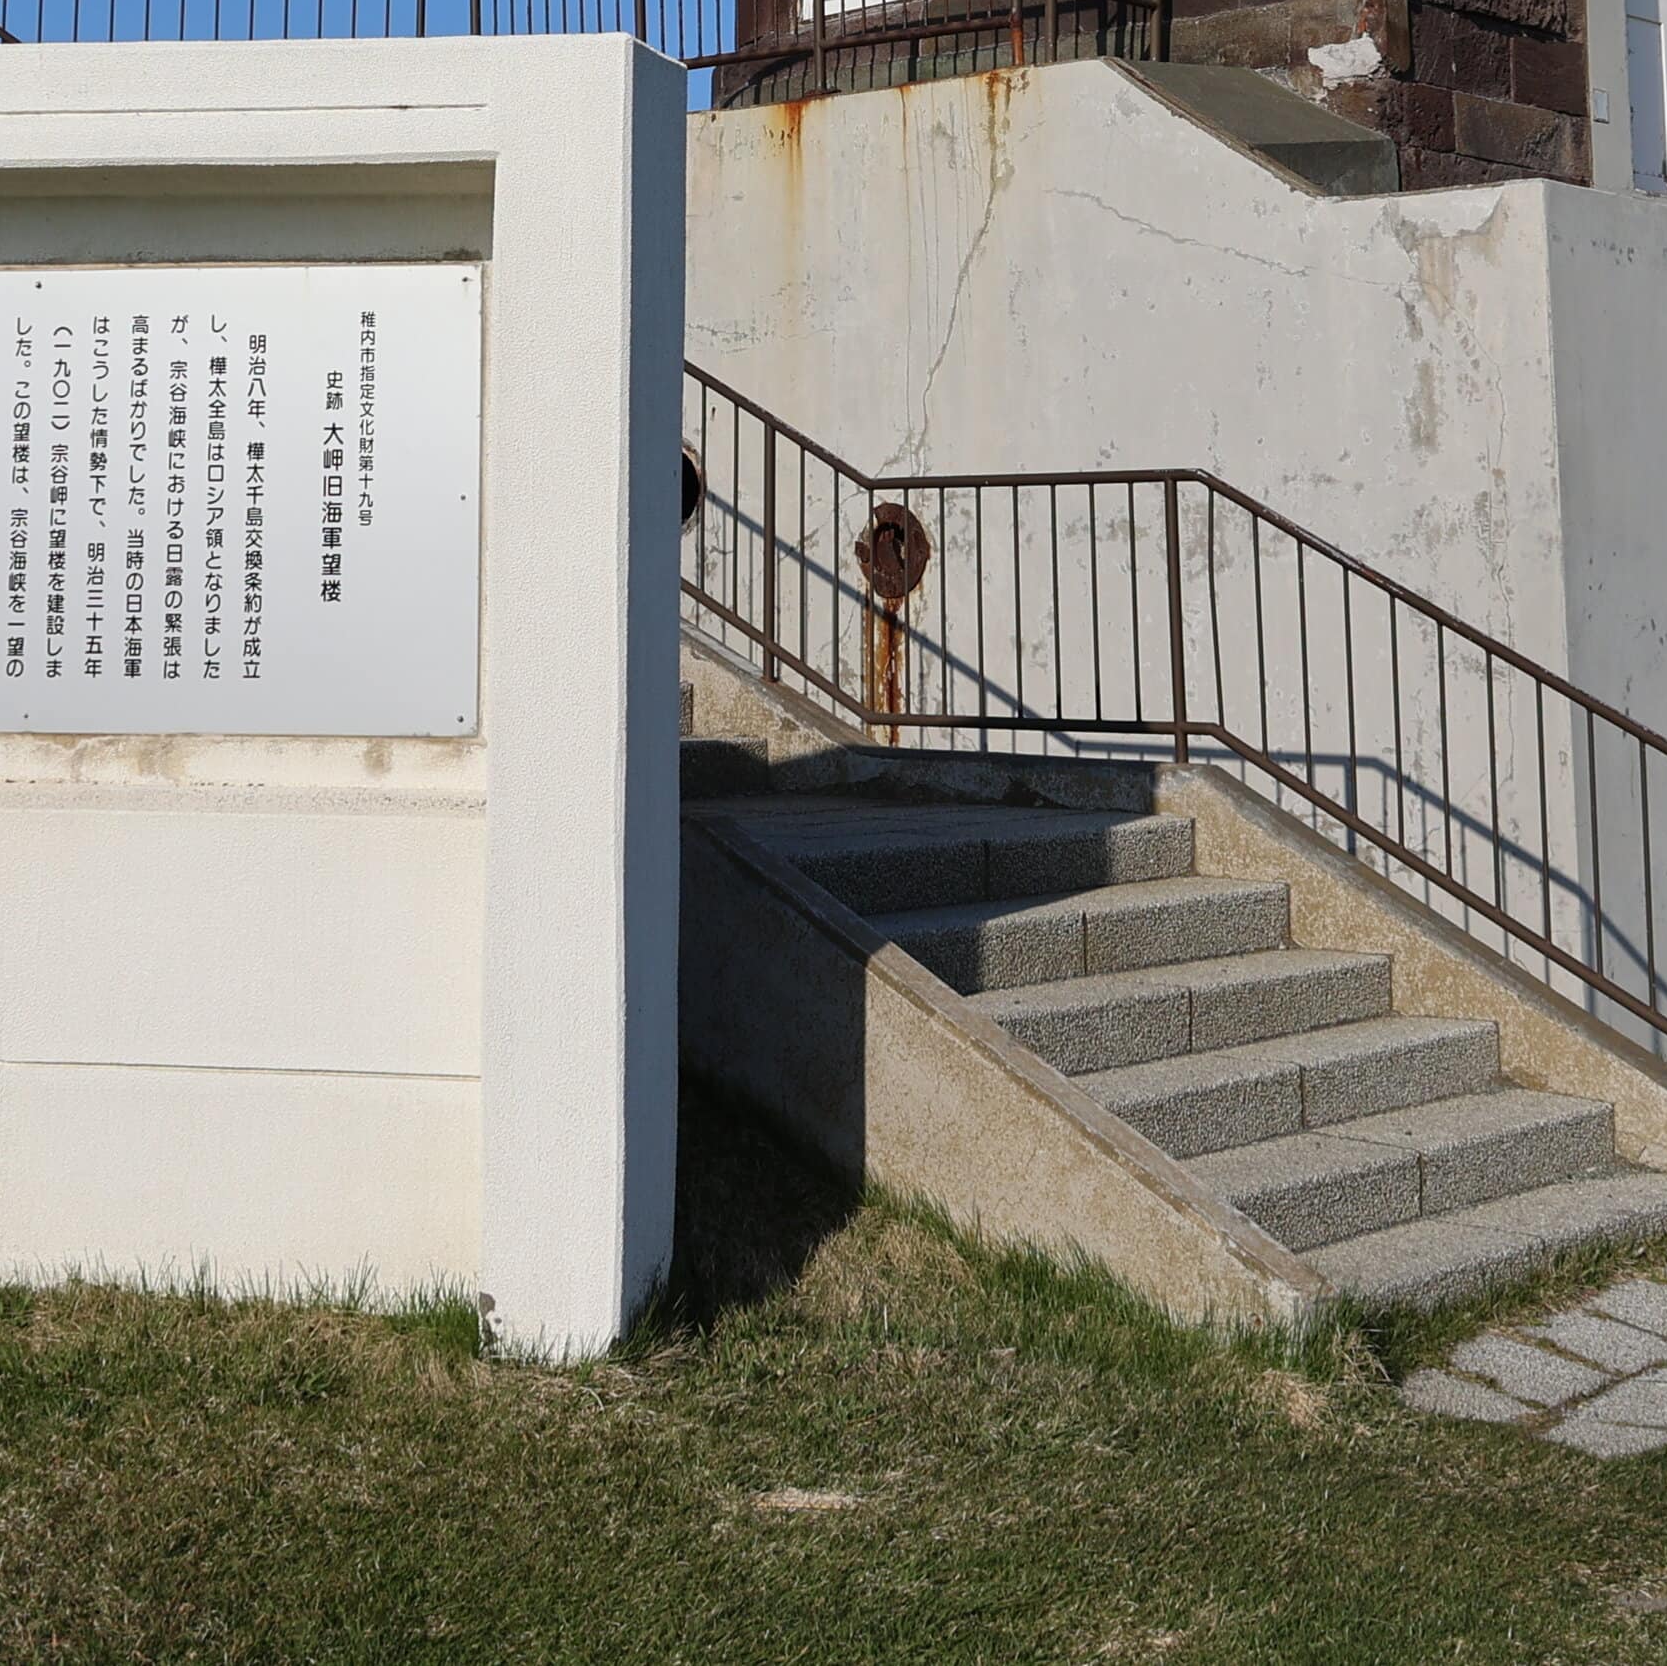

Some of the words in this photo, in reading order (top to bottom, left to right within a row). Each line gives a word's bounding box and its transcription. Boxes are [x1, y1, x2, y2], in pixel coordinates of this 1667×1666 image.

[5, 317, 33, 678] した。この望楼は、宗谷海峡を一望の
[83, 315, 111, 679] はこうした情勢下で、明治三十五年
[123, 314, 150, 679] 高まるばかりでした。当時の日本海軍
[163, 314, 189, 680] が、宗谷海峡における日露の緊張は
[203, 314, 228, 679] し、樺太全島はロシア領となりました
[242, 334, 267, 679] 明治八年、樺太千島交換条約が成立
[320, 422, 344, 603] 大岬旧海軍望楼
[325, 369, 344, 411] 史跡
[357, 310, 376, 527] 稚内市指定文化財第十九号
